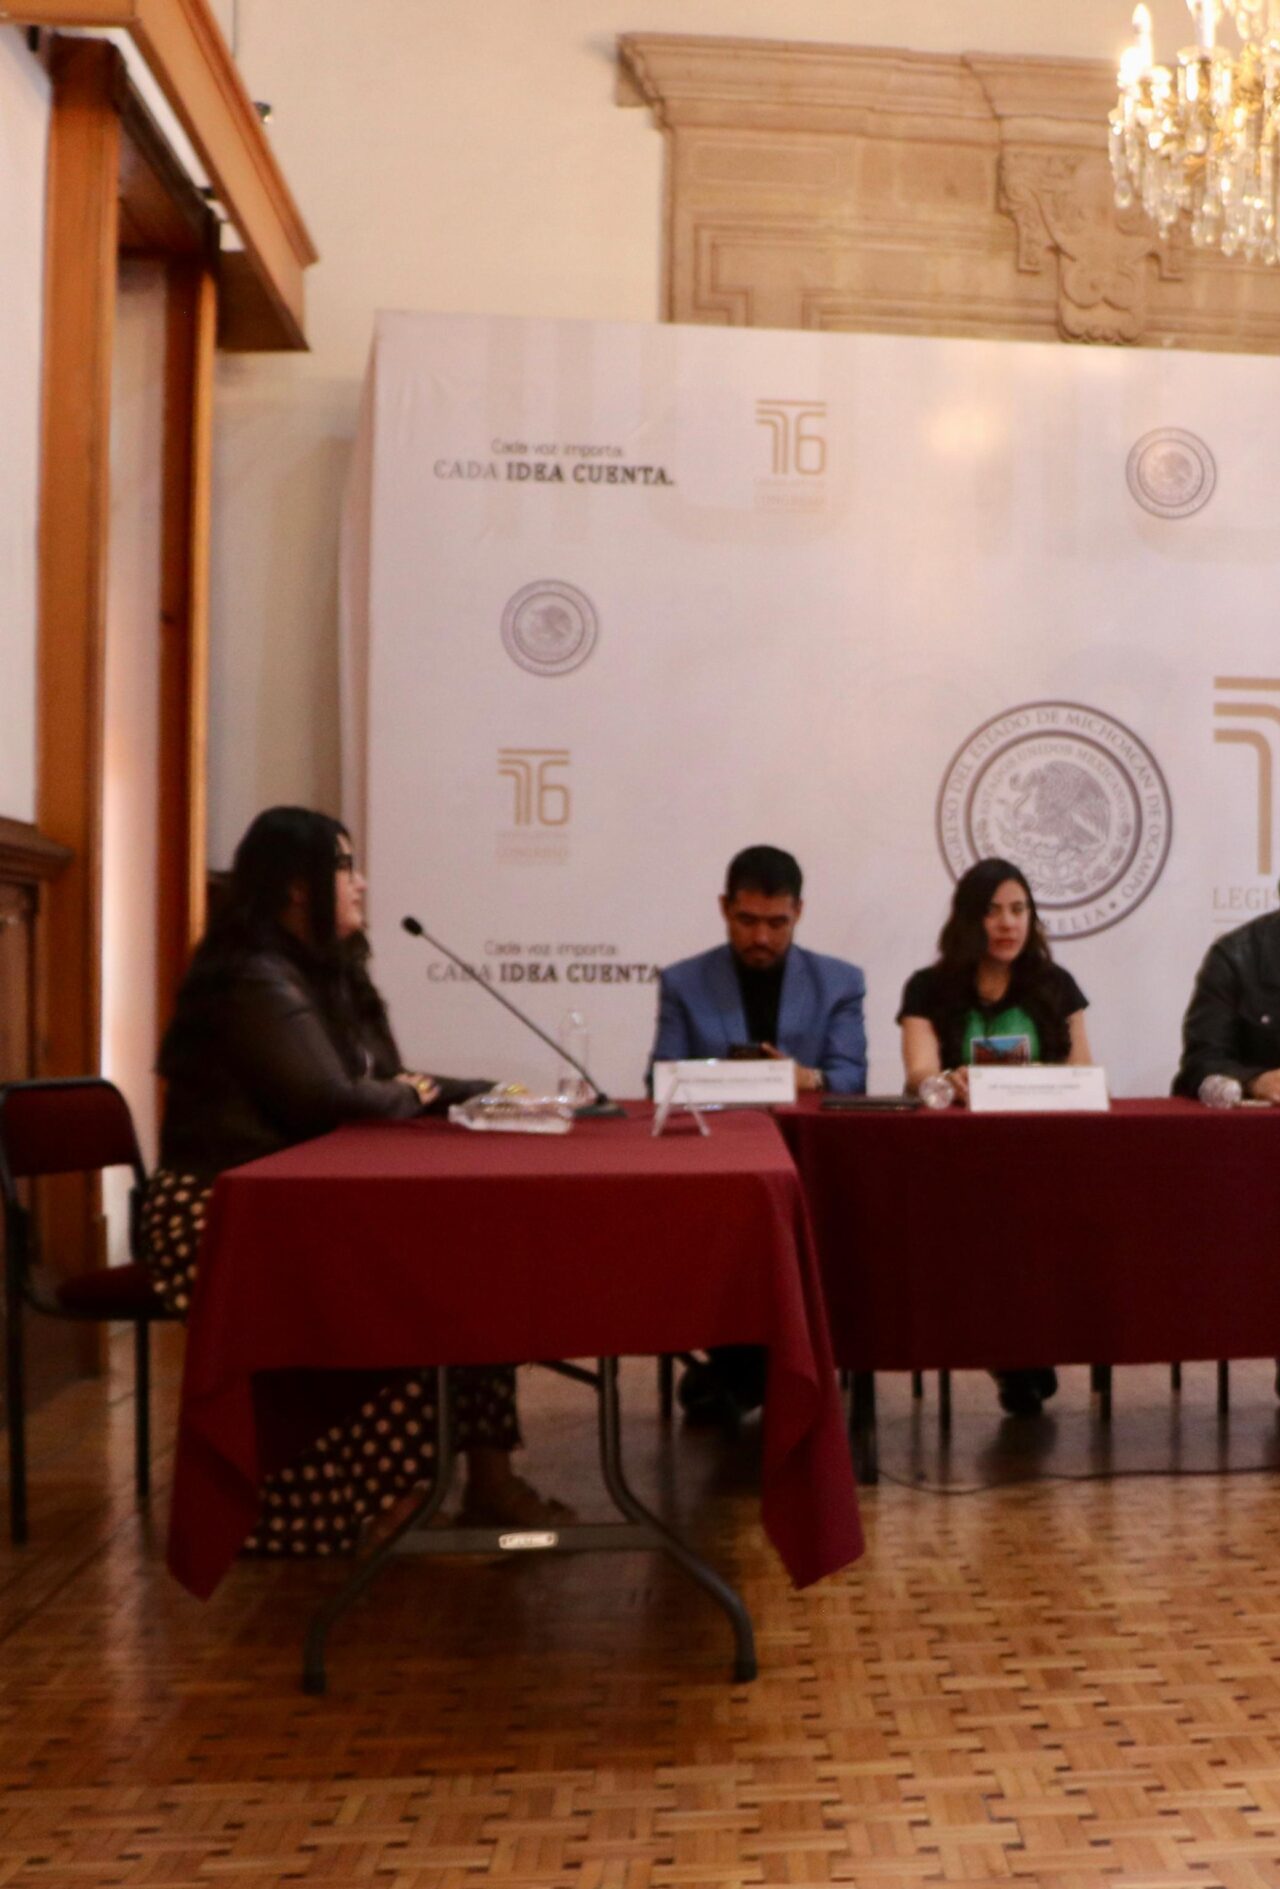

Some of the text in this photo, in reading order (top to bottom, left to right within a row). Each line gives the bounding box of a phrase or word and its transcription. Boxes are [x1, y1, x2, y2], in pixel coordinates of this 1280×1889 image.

[490, 437, 527, 455] Cada
[532, 443, 557, 456] voz
[433, 459, 675, 486] CADA IDEA CUENTA.
[1035, 710, 1059, 725] DE
[499, 963, 558, 984] IDEA
